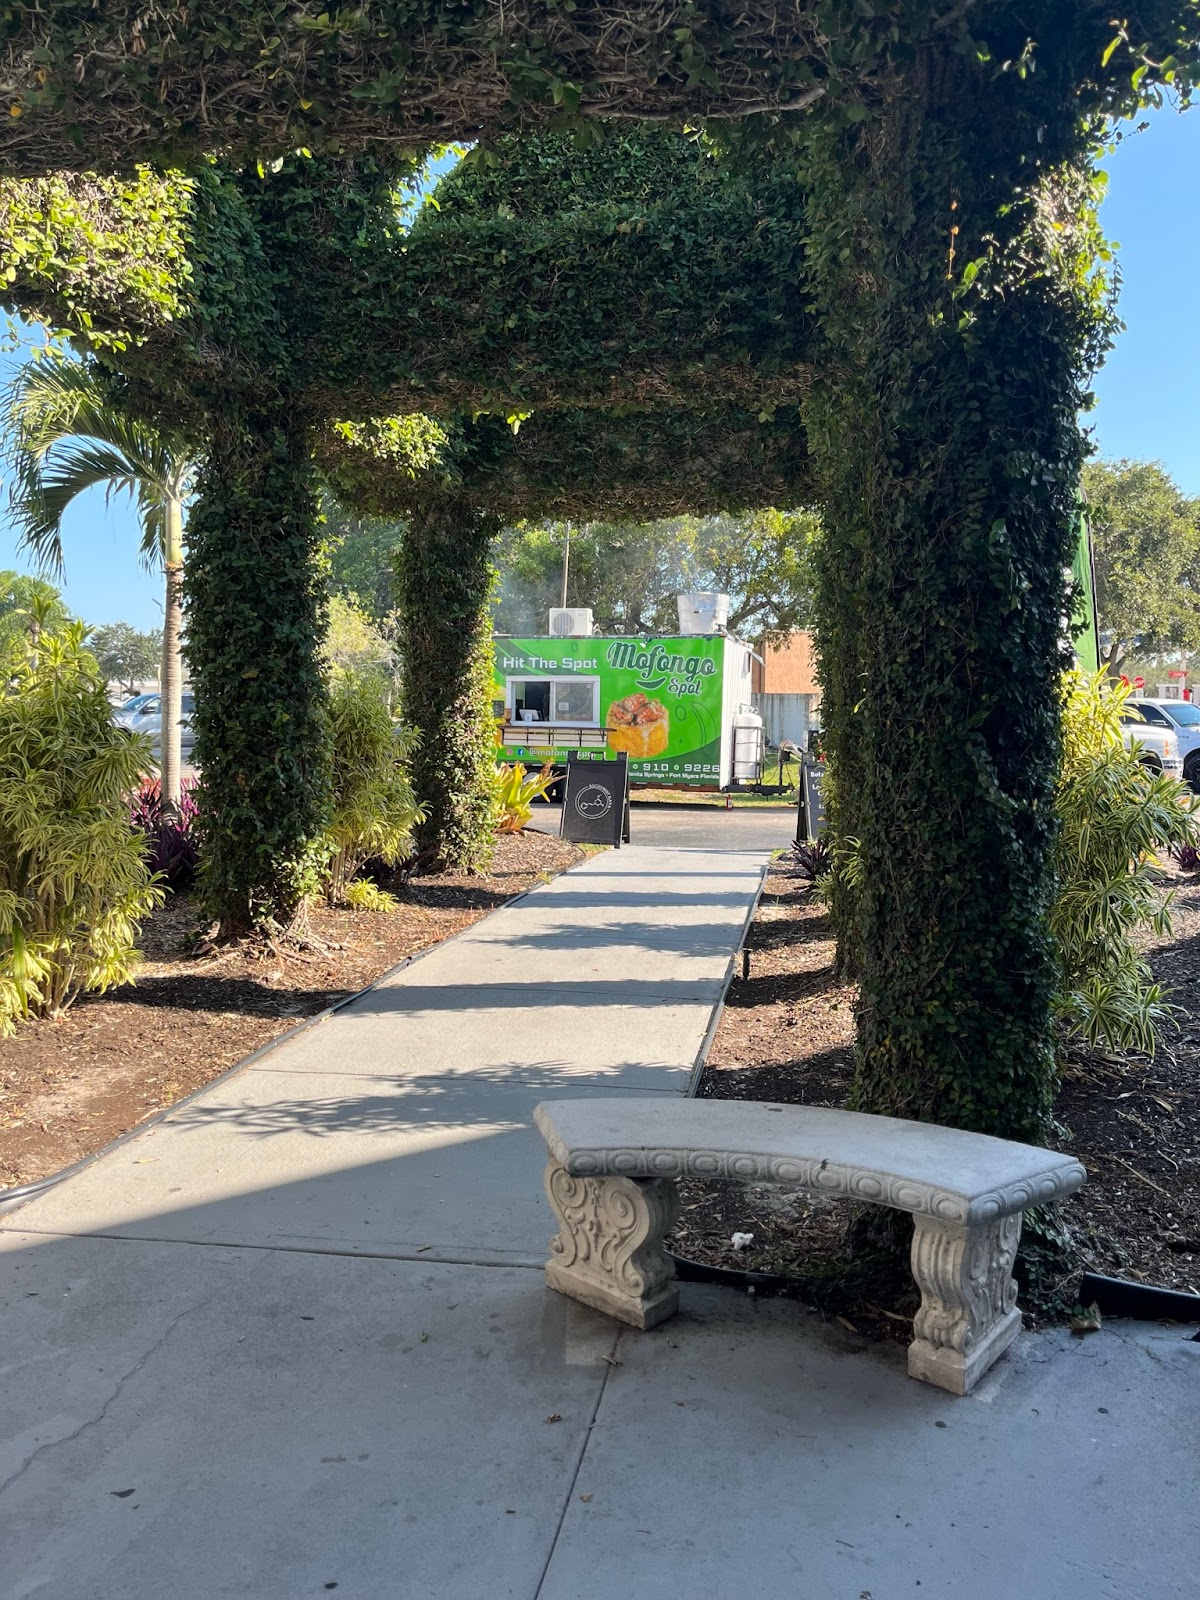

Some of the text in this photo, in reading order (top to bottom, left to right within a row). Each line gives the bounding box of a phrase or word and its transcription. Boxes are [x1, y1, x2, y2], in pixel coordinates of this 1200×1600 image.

[503, 657, 598, 671] Hit The Spot
[606, 641, 717, 682] Mofongo
[667, 677, 702, 699] Spot
[643, 763, 720, 772] 910 9226
